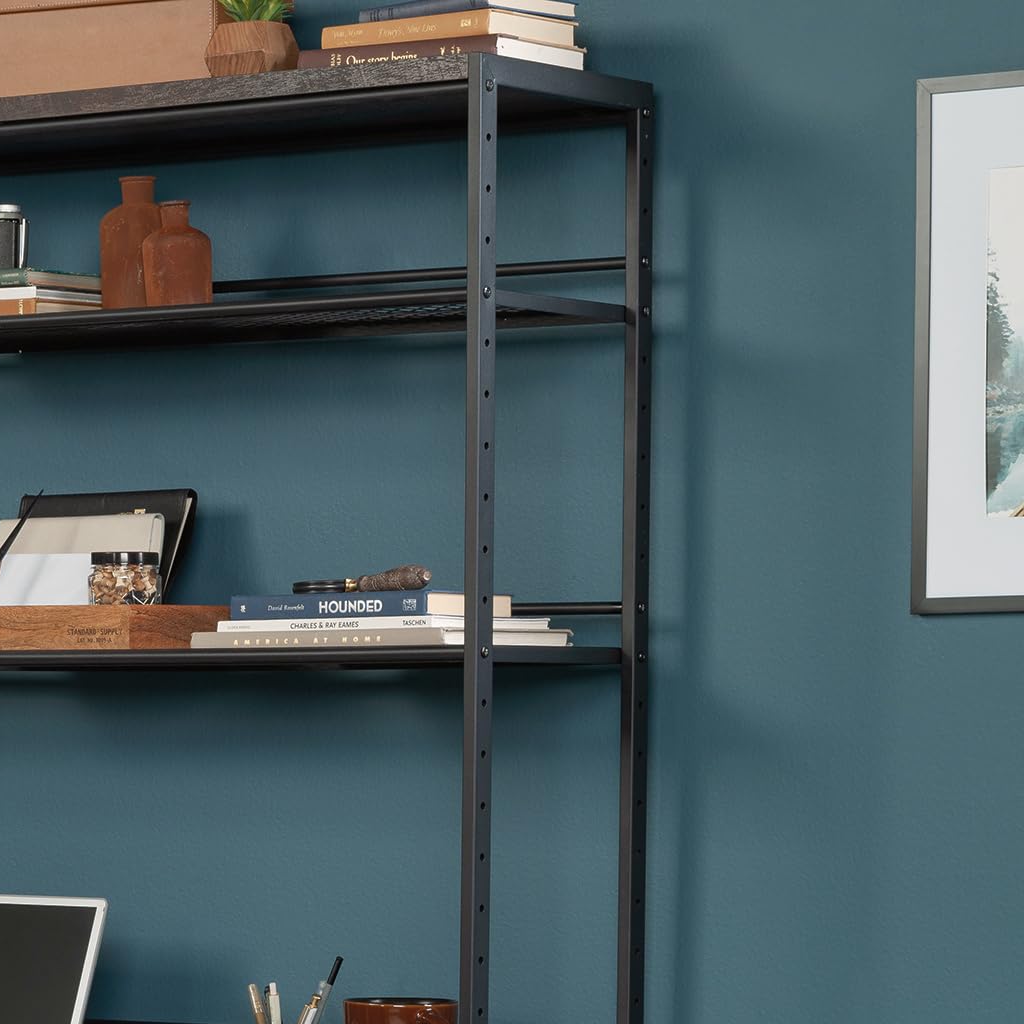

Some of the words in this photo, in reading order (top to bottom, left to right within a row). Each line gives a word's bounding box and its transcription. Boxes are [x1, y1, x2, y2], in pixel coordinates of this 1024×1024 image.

[318, 599, 383, 614] HOUNDED
[67, 628, 96, 636] STANDARD
[100, 627, 123, 635] SUPPLY
[233, 637, 299, 646] AMERICA
[342, 635, 381, 643] HOME
